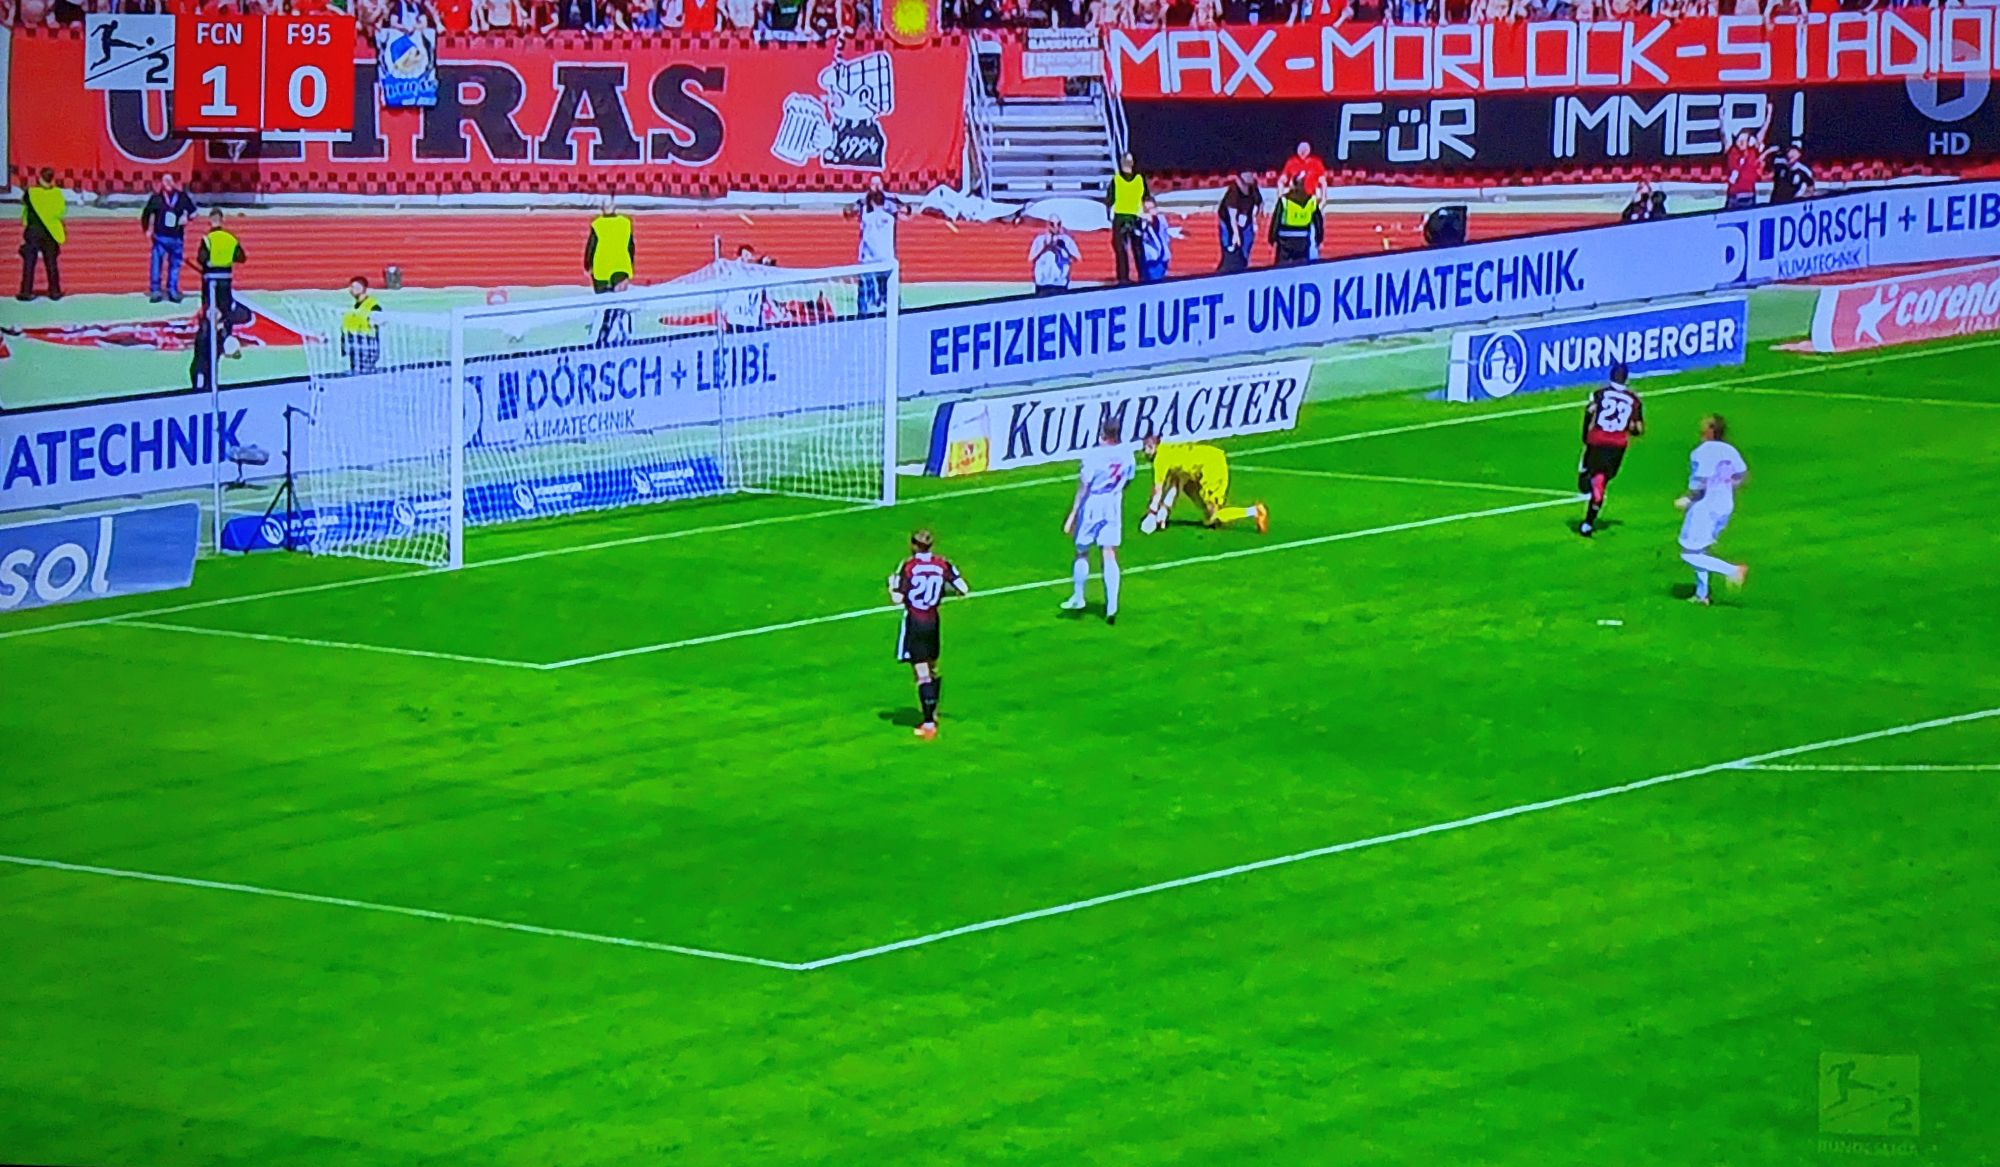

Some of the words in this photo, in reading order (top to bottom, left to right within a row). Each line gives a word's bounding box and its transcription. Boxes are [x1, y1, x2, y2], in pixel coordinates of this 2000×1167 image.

[196, 22, 243, 45] FCN
[286, 23, 332, 46] F95
[1106, 8, 2000, 96] MAX-MORLOCK-STADIO
[146, 53, 169, 84] 2
[200, 65, 238, 117] 1
[288, 65, 328, 118] 0
[840, 135, 879, 160] 1994
[1928, 131, 1971, 156] HD
[1779, 201, 1888, 252] DÖRSCH
[1898, 205, 1917, 232] +
[1927, 193, 2000, 234] LEIB
[1777, 248, 1862, 278] KLIMATECHNIK
[929, 304, 1127, 376] EFFIZIENTE
[1138, 293, 1236, 350] LUFT-
[1248, 283, 1321, 334] UND
[1333, 247, 1584, 322] KLIMATECHNIK.
[1537, 316, 1737, 376] NÜRNBERGER
[526, 356, 662, 411] DÖRSCH
[697, 342, 777, 391] LEIBL
[1002, 377, 1298, 462] KULMBACHER
[1597, 398, 1634, 432] 23
[3, 408, 249, 490] ATECHNIK
[0, 516, 116, 610] sol
[907, 574, 944, 610] 20
